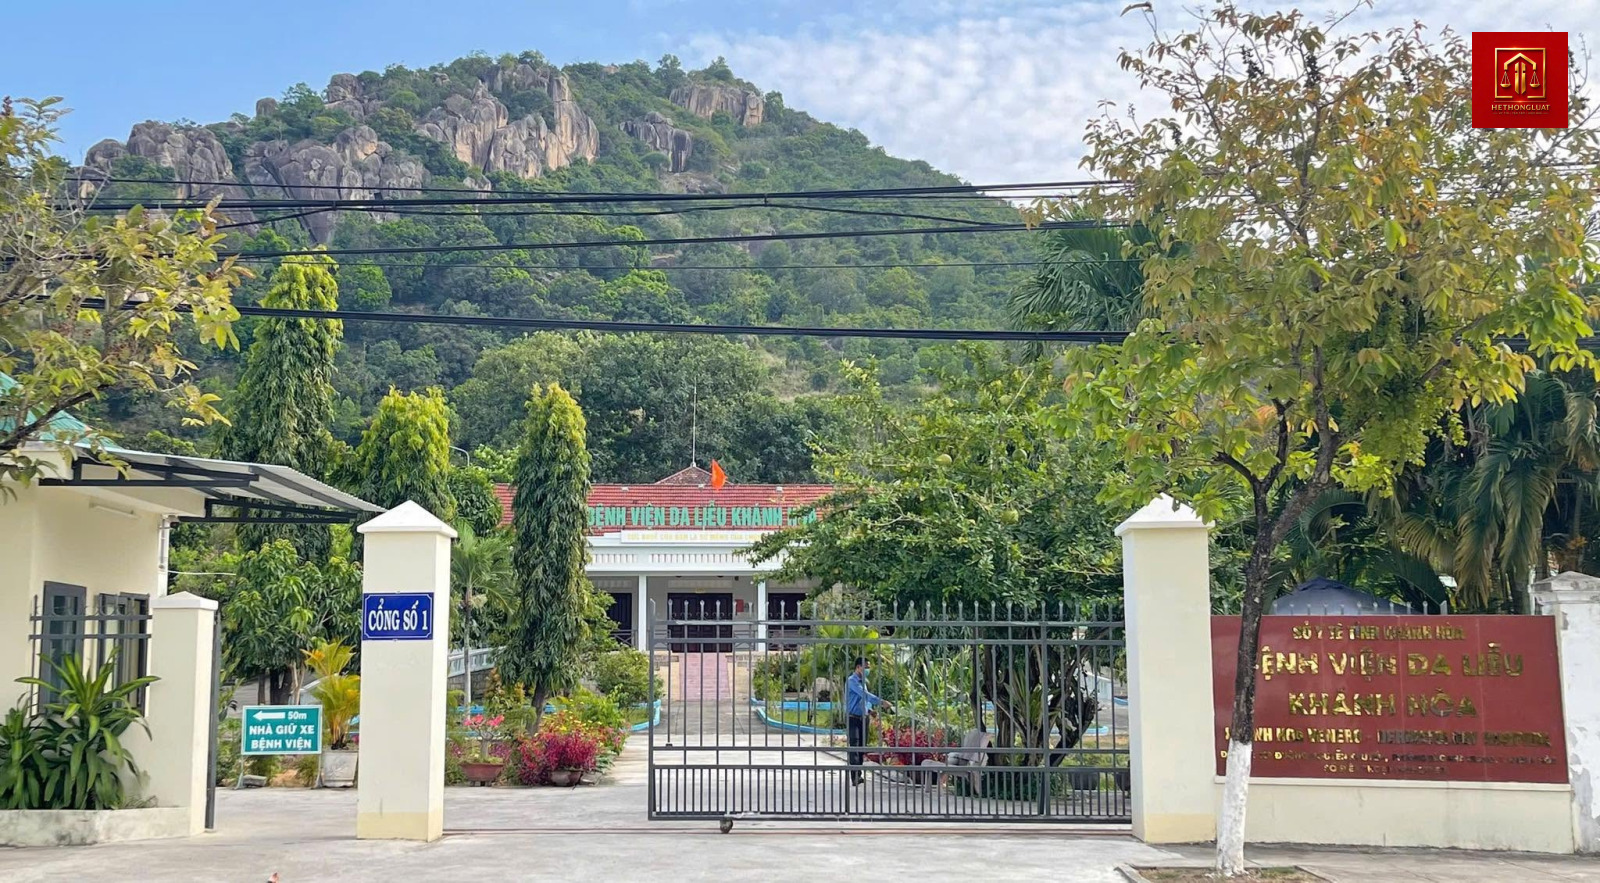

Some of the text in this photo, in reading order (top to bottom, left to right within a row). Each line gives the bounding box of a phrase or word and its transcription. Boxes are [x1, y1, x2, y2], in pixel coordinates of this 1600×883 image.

[631, 502, 665, 530] VIỆN
[669, 506, 690, 527] DA
[731, 502, 783, 527] KHÁNH
[368, 598, 428, 631] CỔNG SỐ 1
[1293, 620, 1312, 640] SỞ
[1314, 624, 1323, 639] Y
[1254, 642, 1523, 681] ỆNH VIỆN DA LIỄU
[1289, 687, 1477, 717] KHÁNH HÒA
[288, 711, 307, 720] 50m
[249, 722, 315, 735] NHÀ GIỮ XE
[251, 736, 312, 751] BỆNH VIỆN
